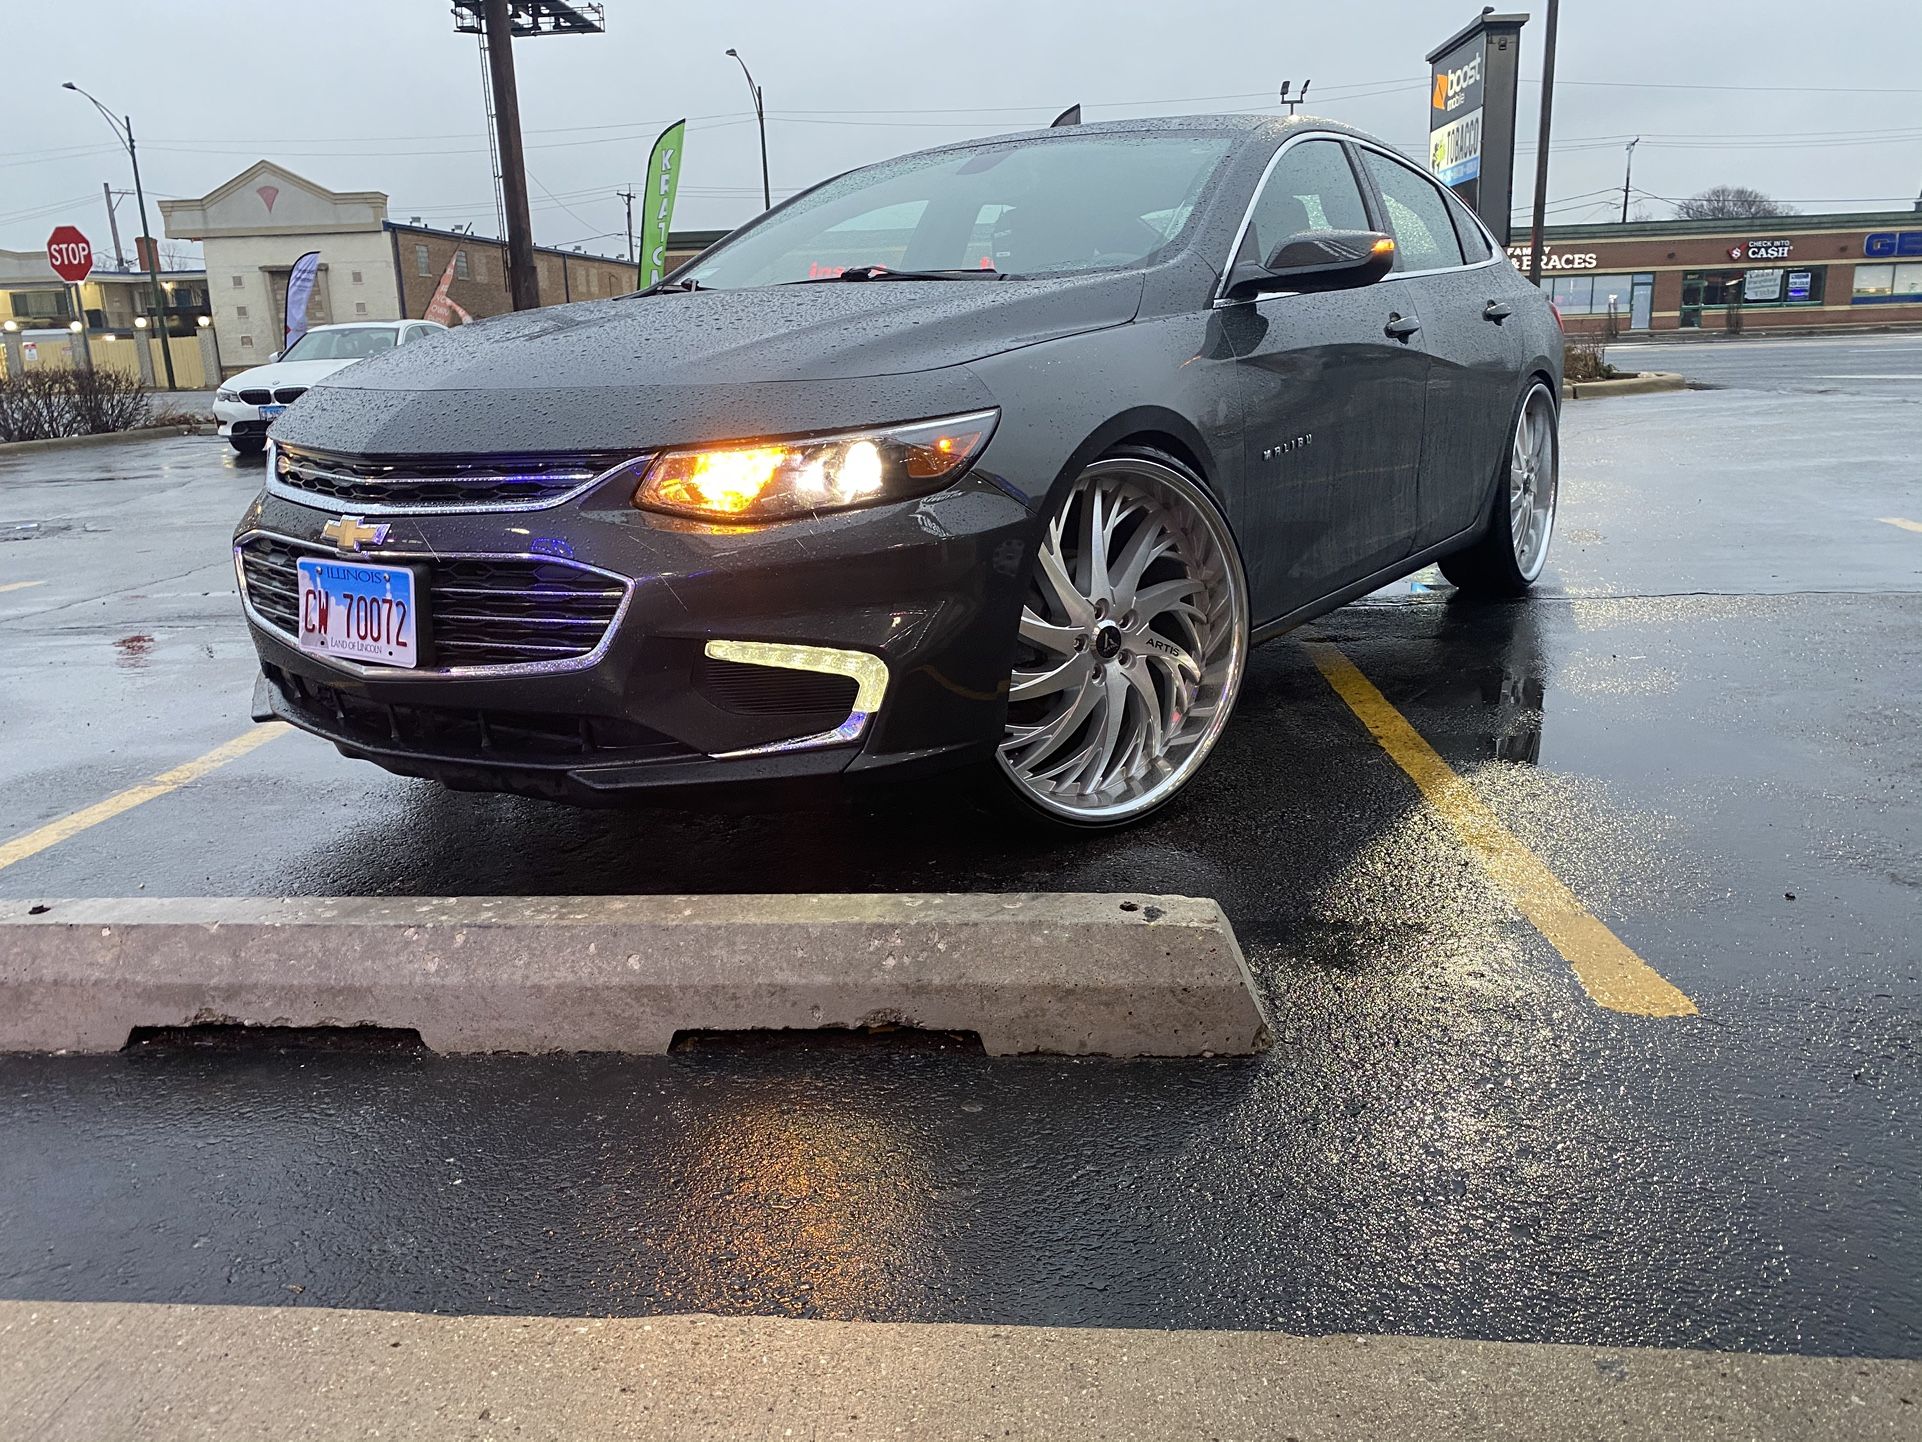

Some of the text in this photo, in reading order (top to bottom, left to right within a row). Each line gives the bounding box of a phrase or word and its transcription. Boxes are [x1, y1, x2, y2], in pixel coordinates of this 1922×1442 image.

[1447, 52, 1481, 97] boost
[1446, 92, 1465, 112] mobile
[1446, 116, 1480, 167] TOBACCO
[50, 242, 89, 266] STOP
[1506, 246, 1551, 256] FAMY
[1748, 240, 1772, 248] CHECK
[1262, 433, 1312, 461] MALIBU
[326, 567, 382, 584] ILLINOIS
[304, 589, 408, 648] CW 70072
[330, 637, 348, 649] LAND
[356, 642, 382, 654] LINCOLN
[1146, 638, 1180, 657] ARTIS
